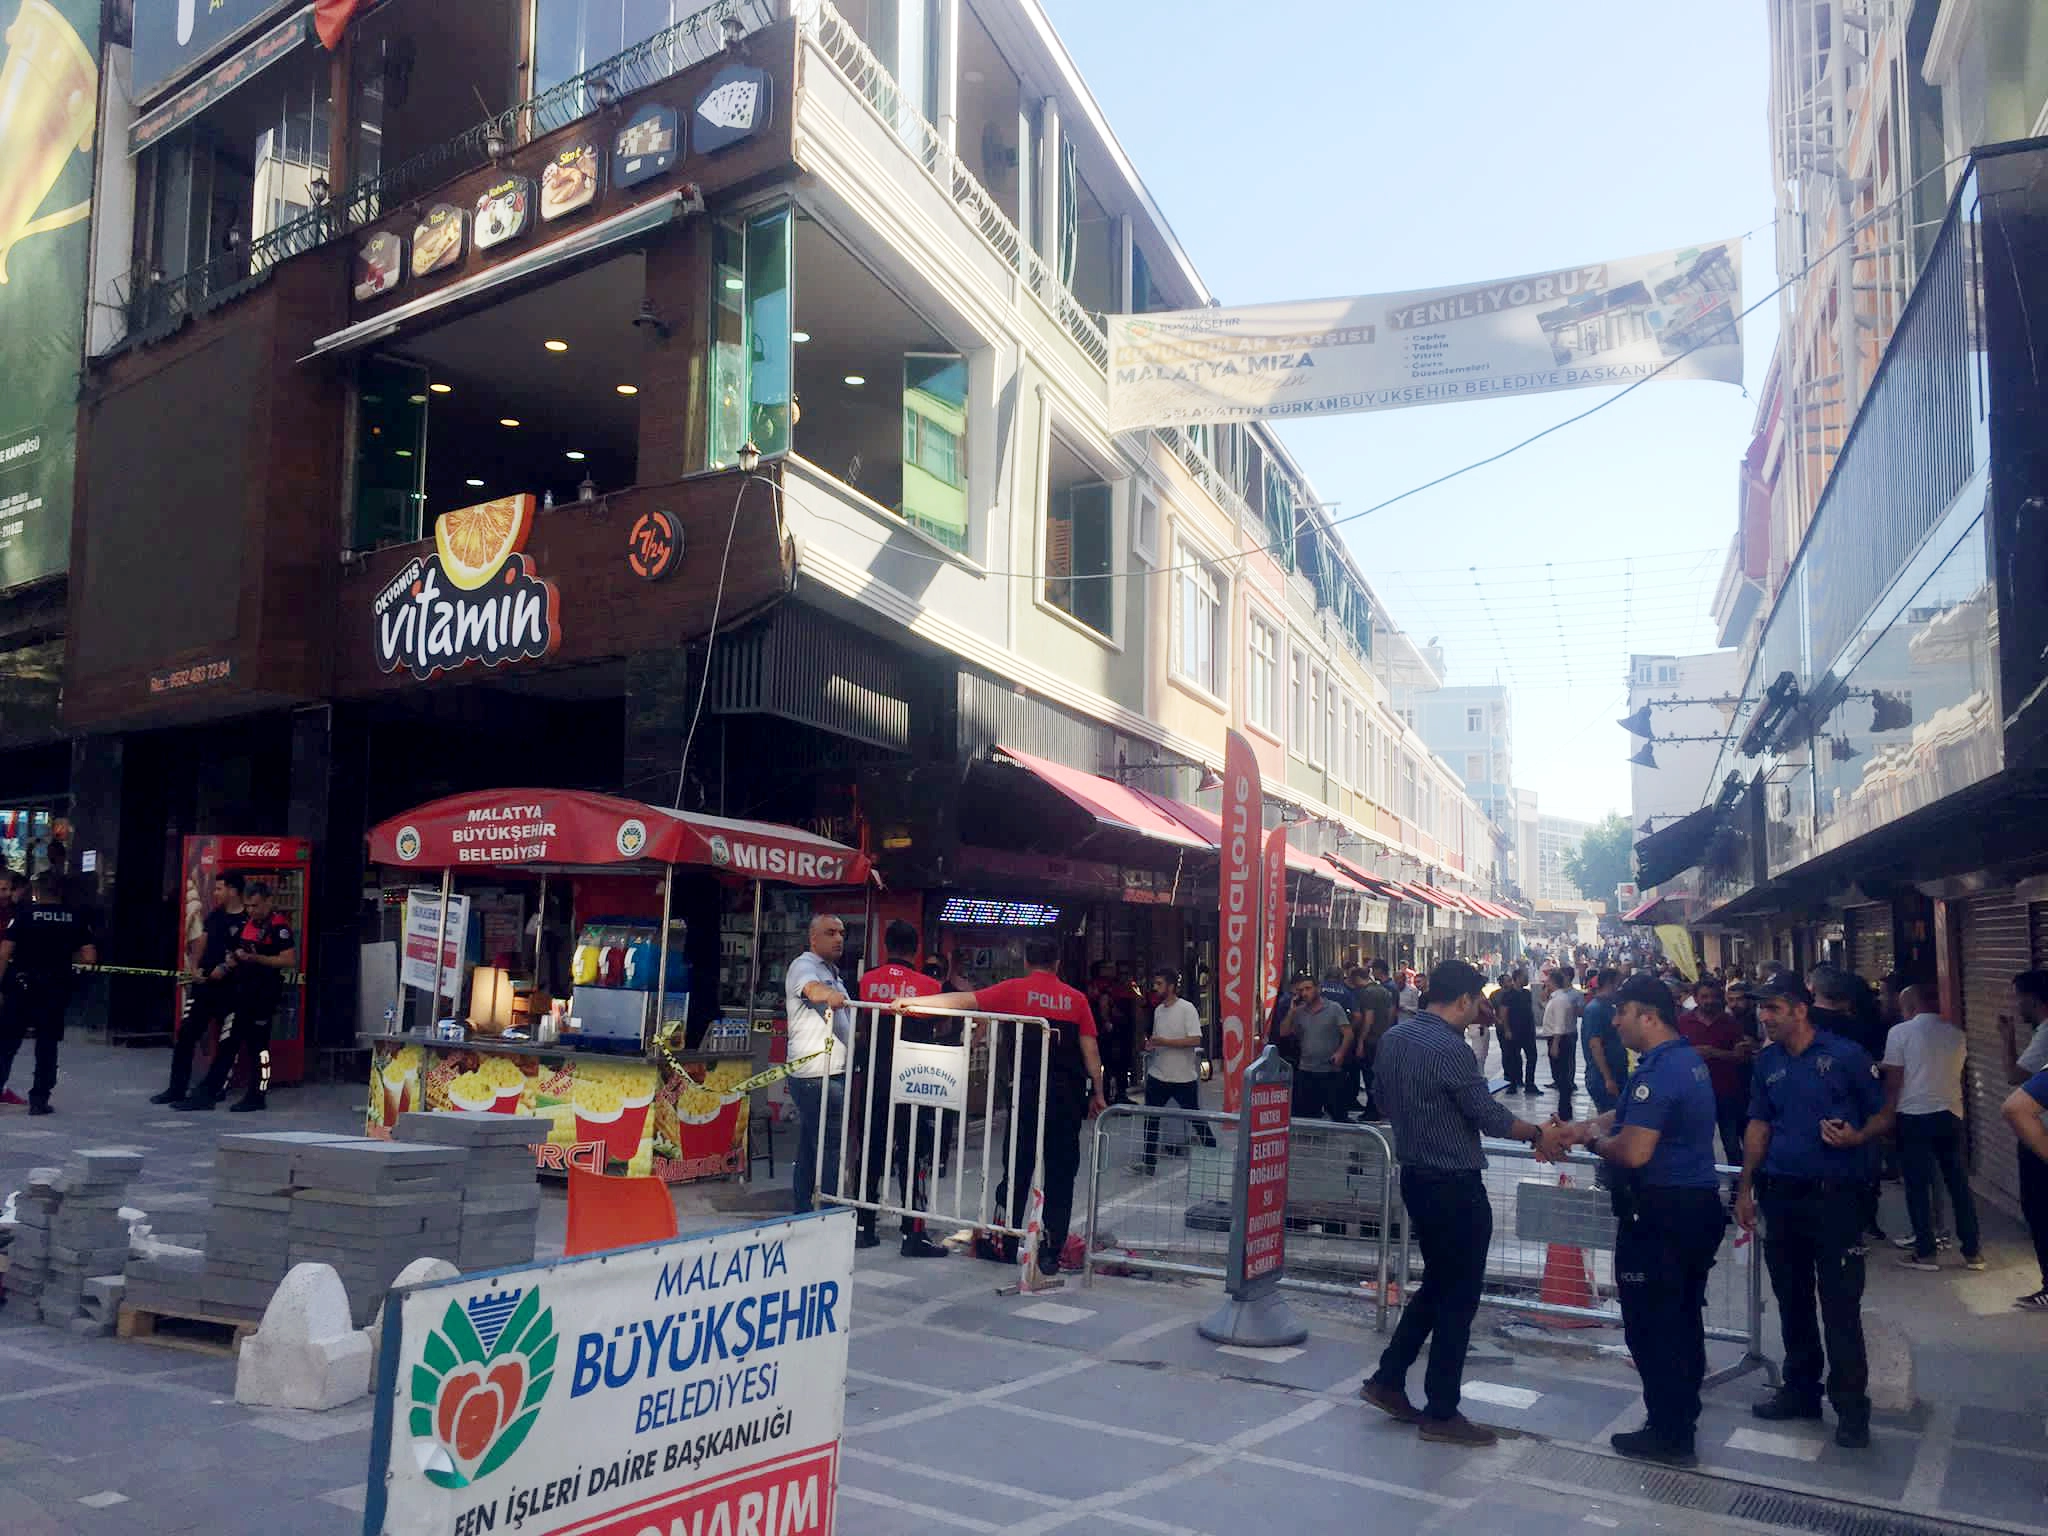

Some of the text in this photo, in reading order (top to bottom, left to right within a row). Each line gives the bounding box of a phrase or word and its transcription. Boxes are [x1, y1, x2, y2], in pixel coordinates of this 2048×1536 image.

[1393, 271, 1604, 327] YENİLİYORUZ
[375, 563, 420, 616] OKYANUS
[381, 566, 543, 668] vitamin
[452, 822, 556, 844] BÜYÜKŞEHİR
[467, 804, 542, 822] MALATYA
[459, 840, 547, 862] BELEDİYESİ
[905, 1081, 948, 1097] ZABITA
[654, 1239, 788, 1302] MALATYA
[570, 1280, 841, 1399] BÜYÜKŞEHİR
[635, 1361, 778, 1434] BELEDİYESİ
[454, 1405, 794, 1536] FEN İŞLERİ DAİRE BAŞKANLIĞI
